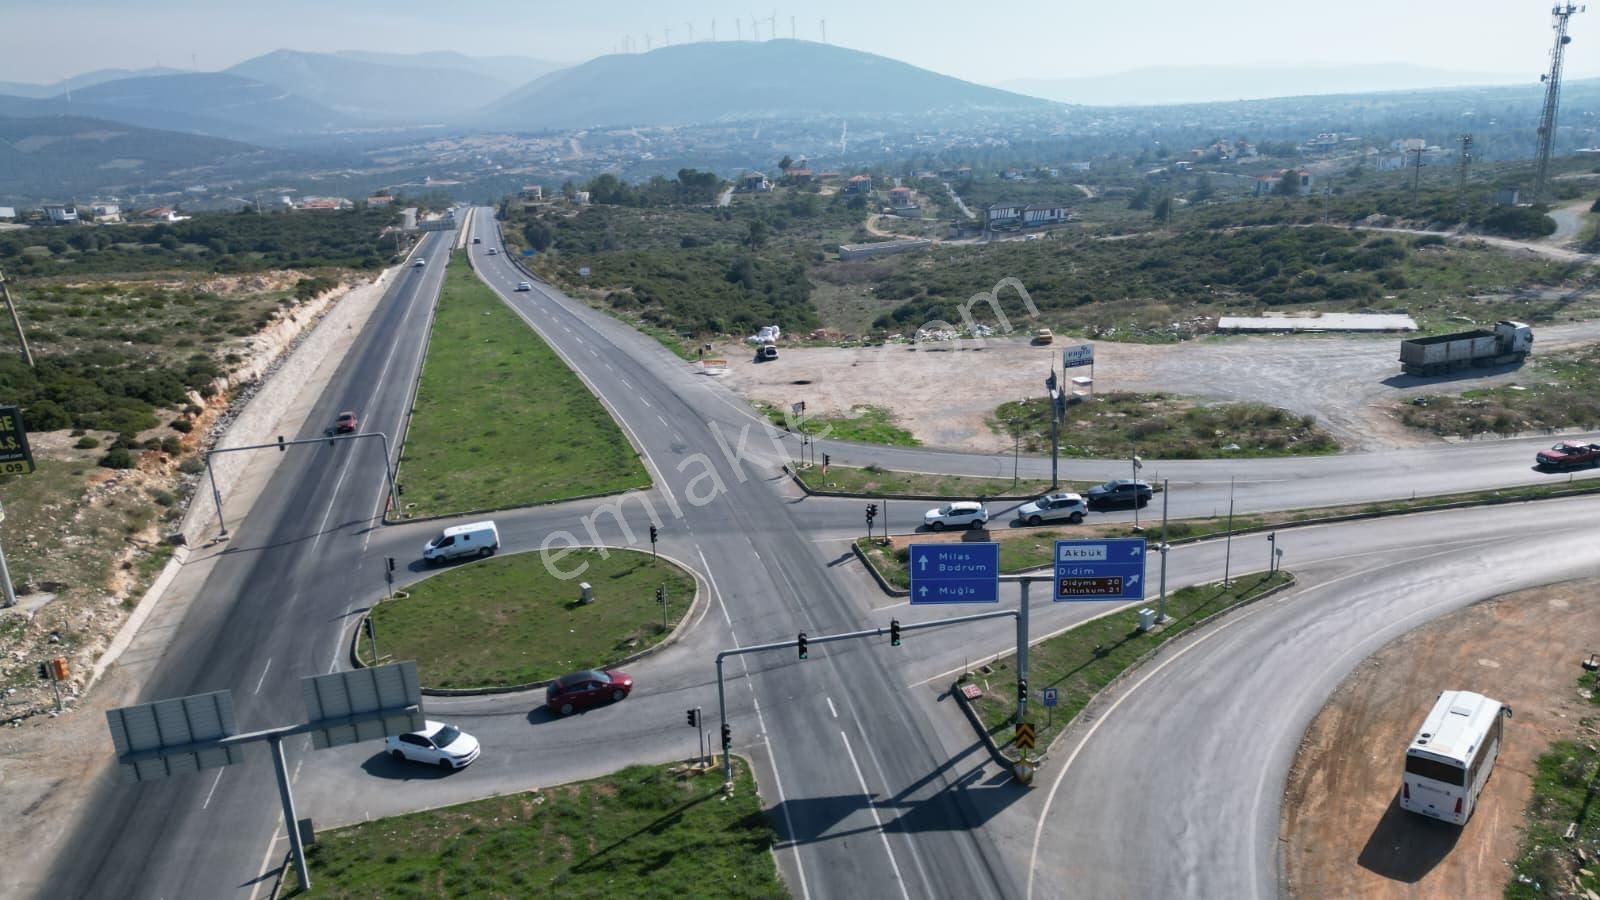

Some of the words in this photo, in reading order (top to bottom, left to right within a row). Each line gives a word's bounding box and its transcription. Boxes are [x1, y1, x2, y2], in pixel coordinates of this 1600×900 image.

[938, 552, 971, 561] Milas
[938, 563, 987, 572] Bodrum
[1059, 567, 1095, 576] Didim
